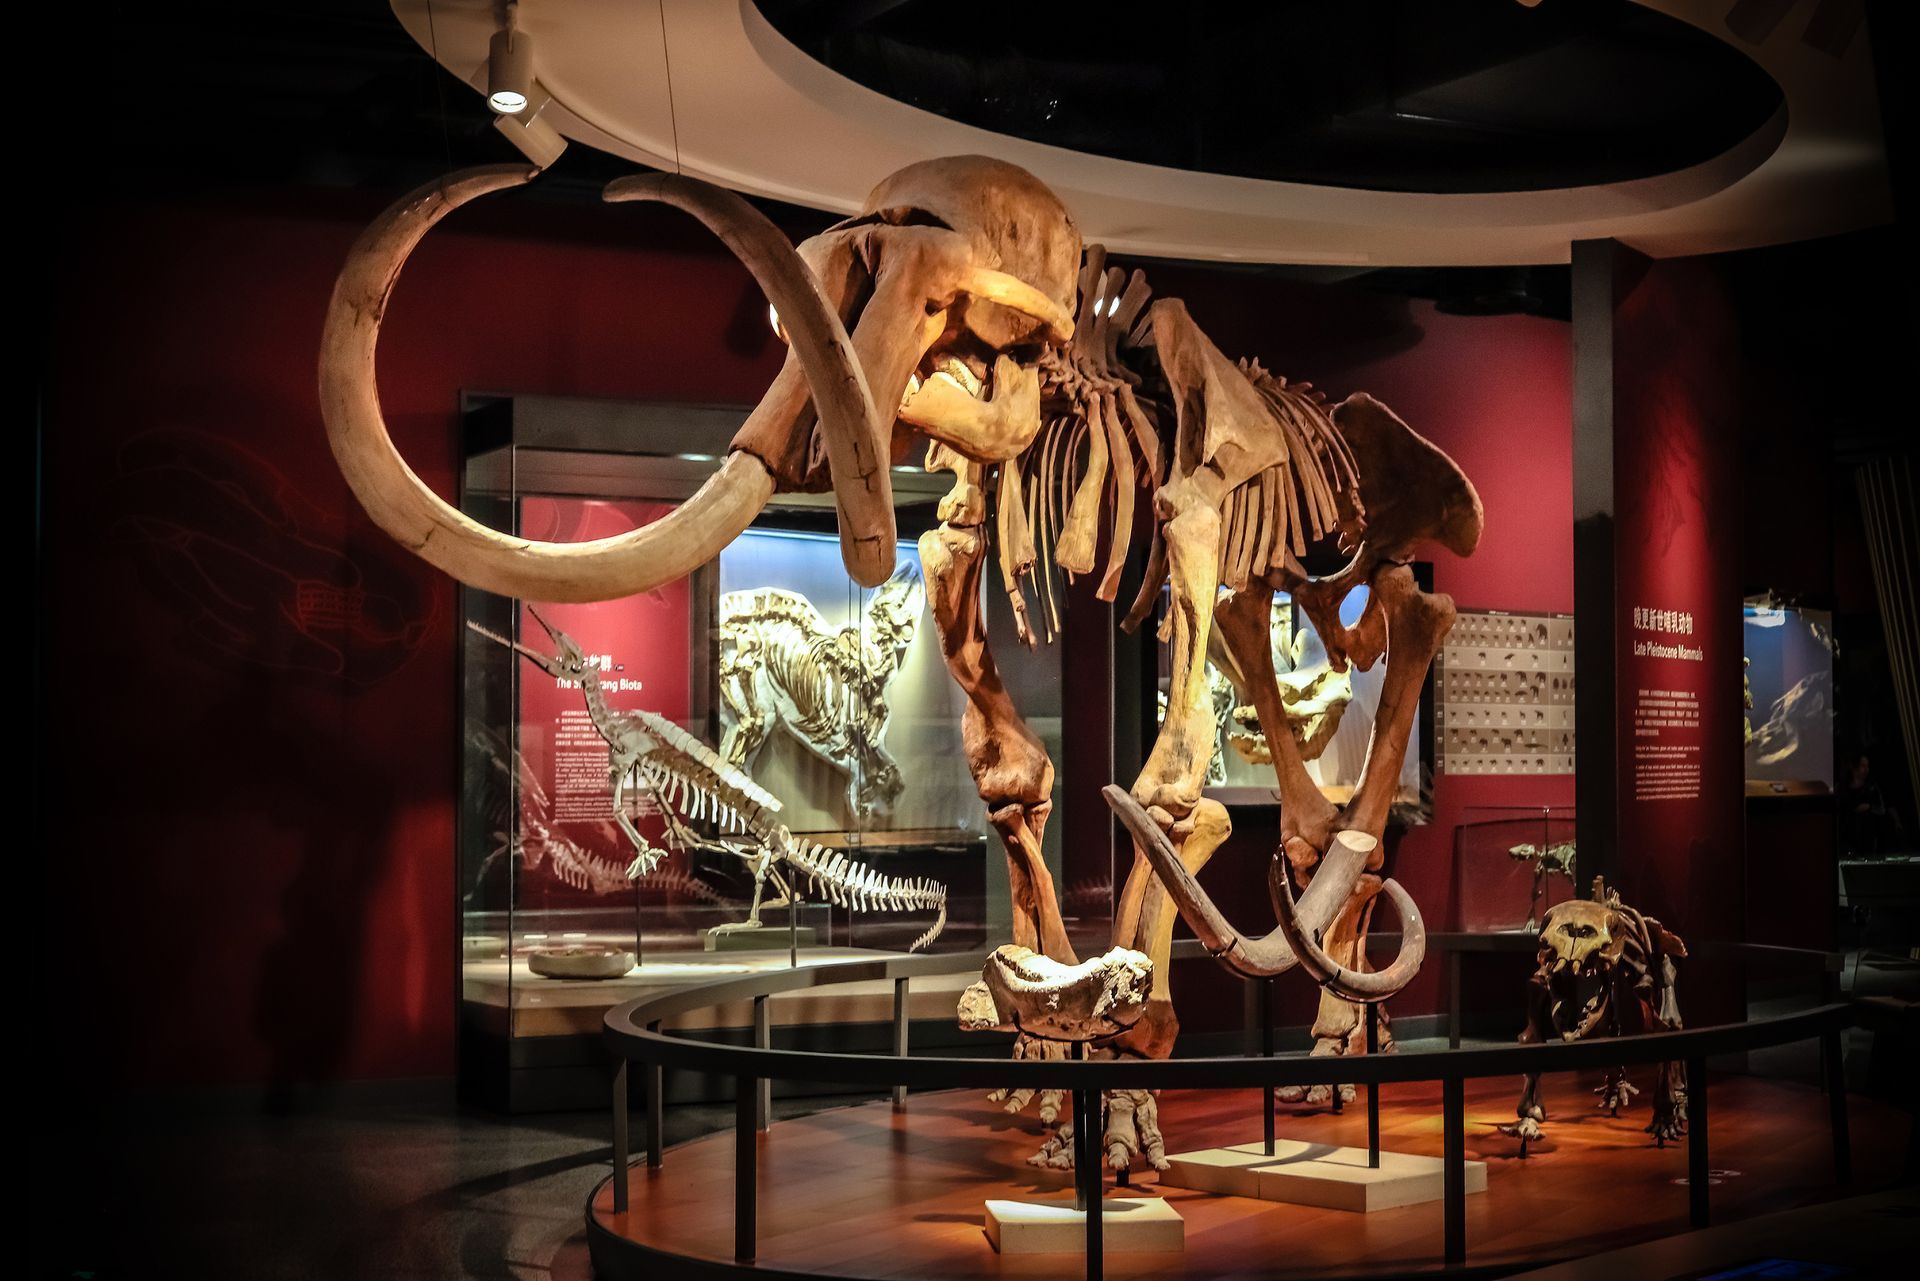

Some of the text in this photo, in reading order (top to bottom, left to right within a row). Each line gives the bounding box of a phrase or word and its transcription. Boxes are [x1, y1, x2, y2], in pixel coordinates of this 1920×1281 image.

[1633, 606, 1693, 635] 晚更新世哺乳动物
[1634, 640, 1703, 661] Late Pleistocene Mammals
[556, 677, 572, 688] The
[620, 678, 642, 690] Biota
